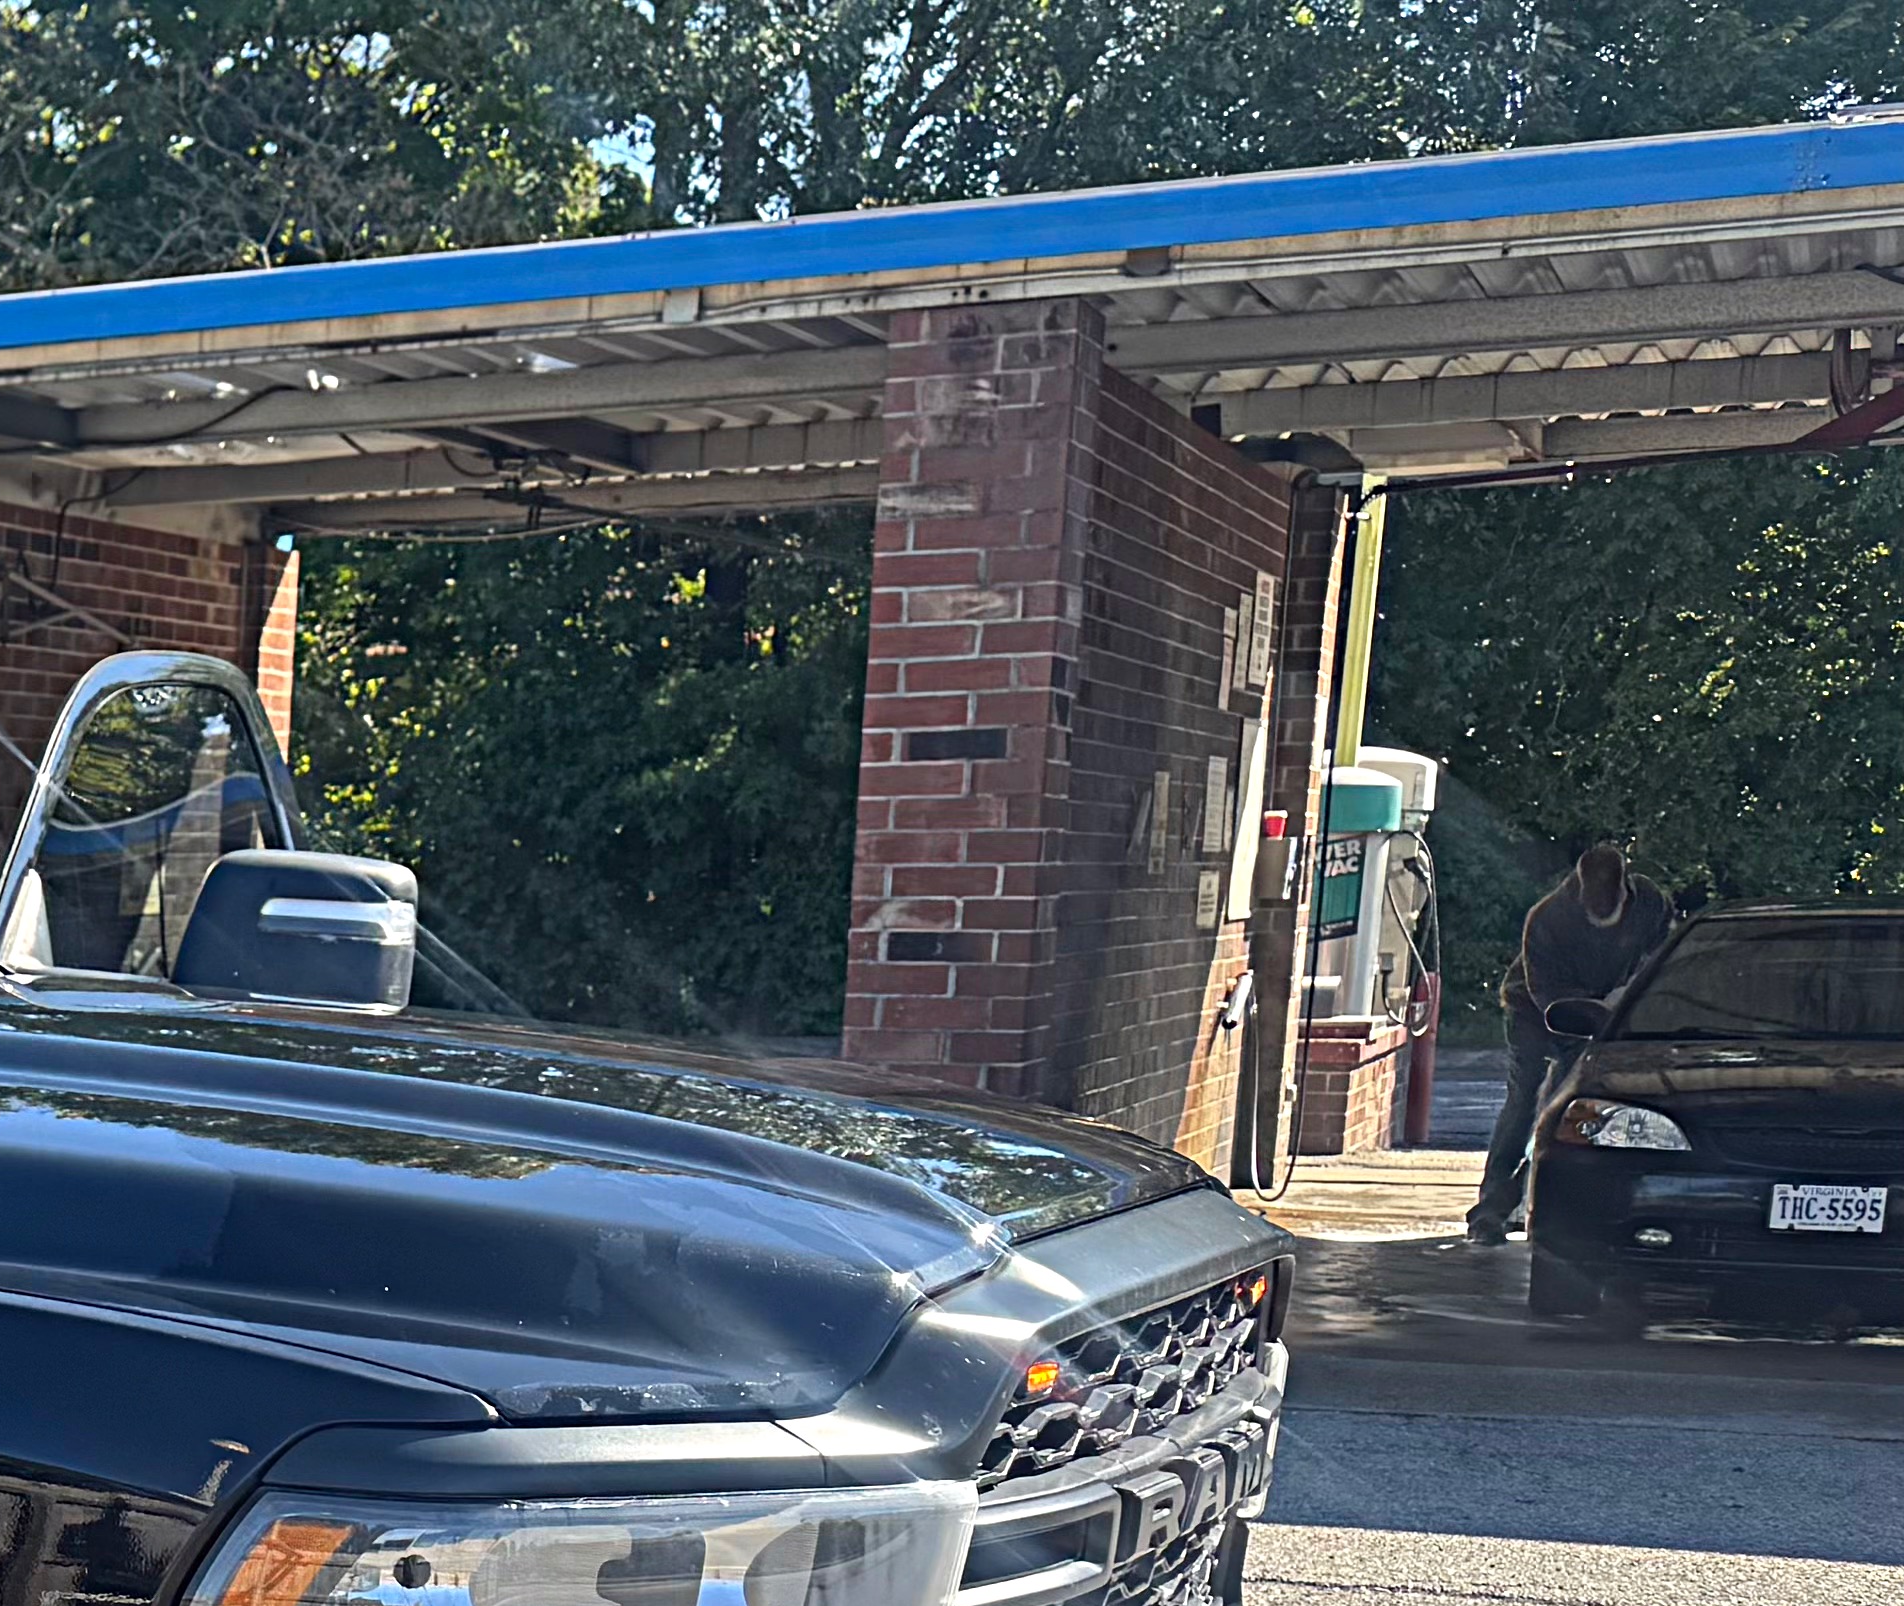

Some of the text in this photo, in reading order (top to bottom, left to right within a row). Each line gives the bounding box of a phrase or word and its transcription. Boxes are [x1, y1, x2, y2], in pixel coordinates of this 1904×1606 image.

[1317, 840, 1361, 860] WER
[1802, 1187, 1858, 1197] VIRGINIA
[1778, 1196, 1882, 1222] THC-5595
